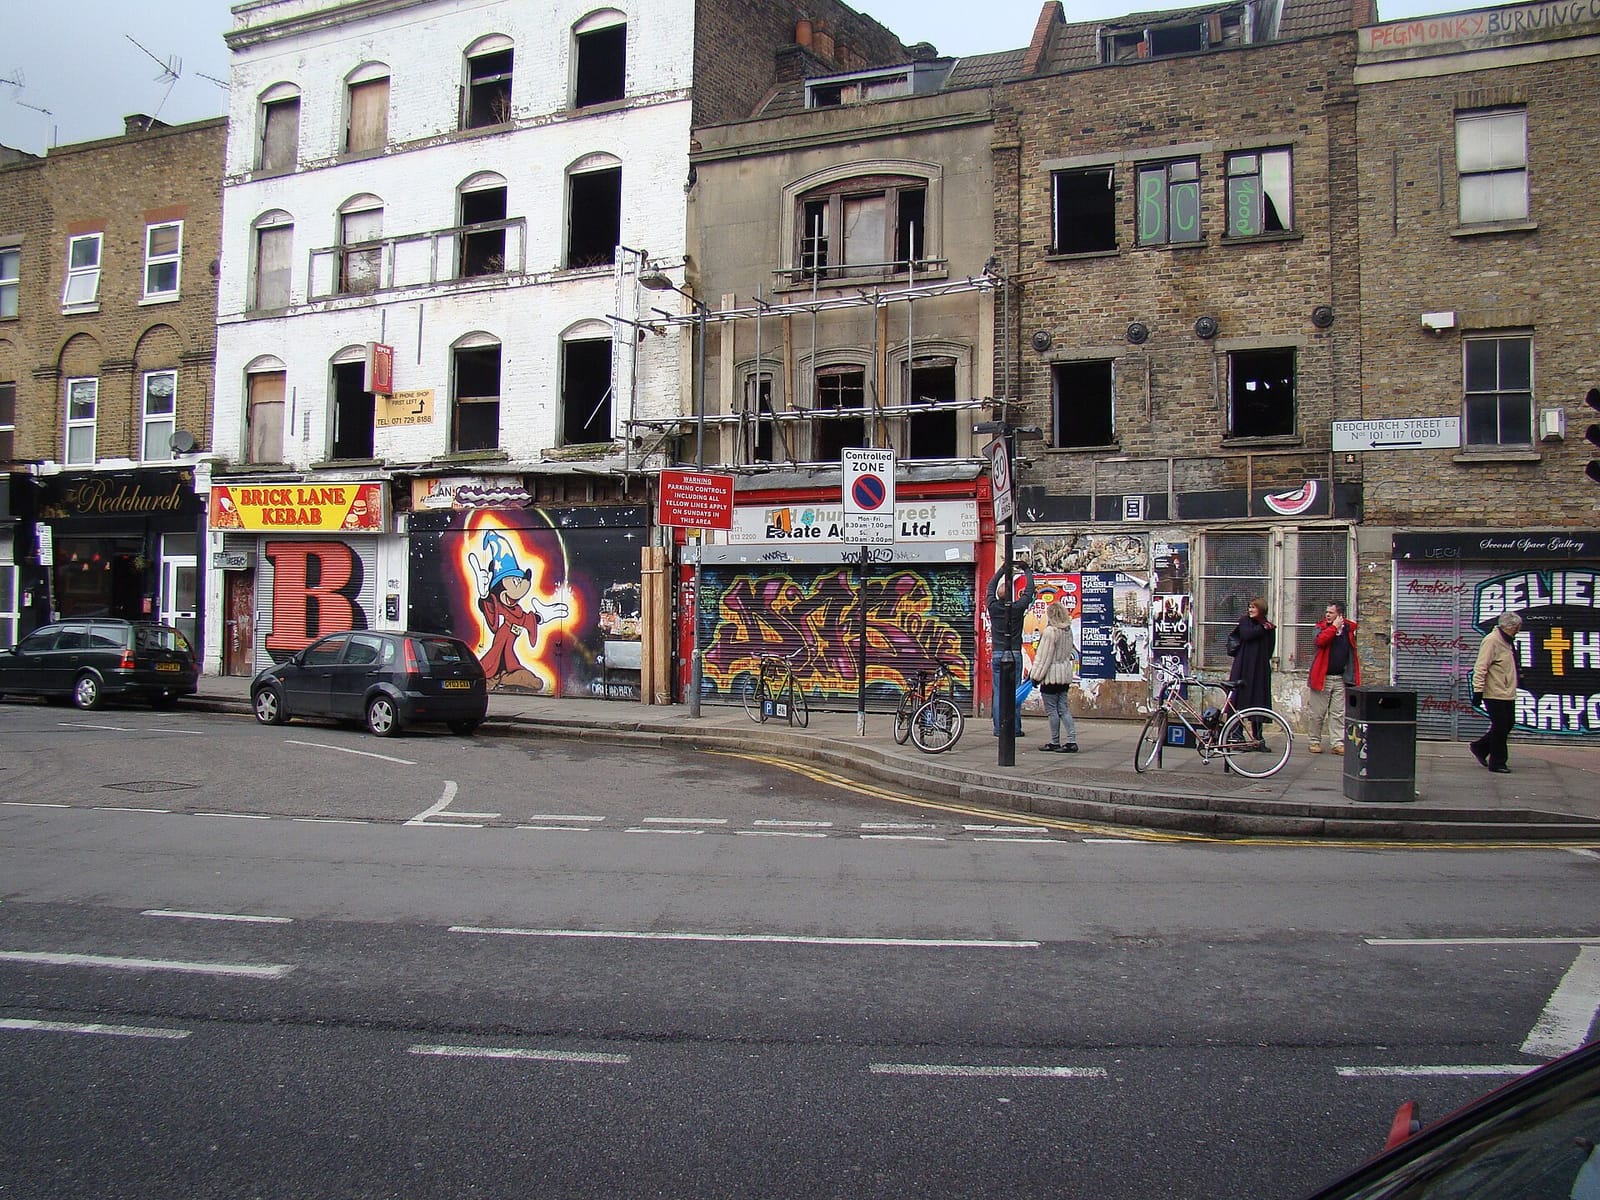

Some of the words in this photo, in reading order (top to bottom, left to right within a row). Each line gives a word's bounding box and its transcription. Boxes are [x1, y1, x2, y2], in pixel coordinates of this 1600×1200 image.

[1335, 421, 1399, 432] REDCHURCH
[1403, 420, 1441, 429] STREET
[1410, 429, 1441, 439] (ODD)
[845, 451, 892, 461] Controlled
[852, 462, 885, 472] ZONE
[683, 476, 712, 485] WARNING
[667, 484, 694, 492] PARKING
[695, 486, 727, 494] CONTROLS
[77, 478, 182, 513] Redchurch
[240, 488, 294, 506] BRICK
[297, 487, 346, 505] LANE
[674, 492, 708, 501] INCLUDING
[690, 501, 708, 509] LINES
[262, 508, 322, 525] KEBAB
[684, 509, 712, 517] SUNDAYS
[901, 521, 936, 536] Ltd.
[1479, 538, 1513, 550] Second
[1517, 538, 1545, 551] Space
[1547, 538, 1585, 552] Gallery
[1478, 572, 1600, 625] BELIE
[1155, 621, 1187, 633] NE-YO
[1172, 728, 1183, 742] P
